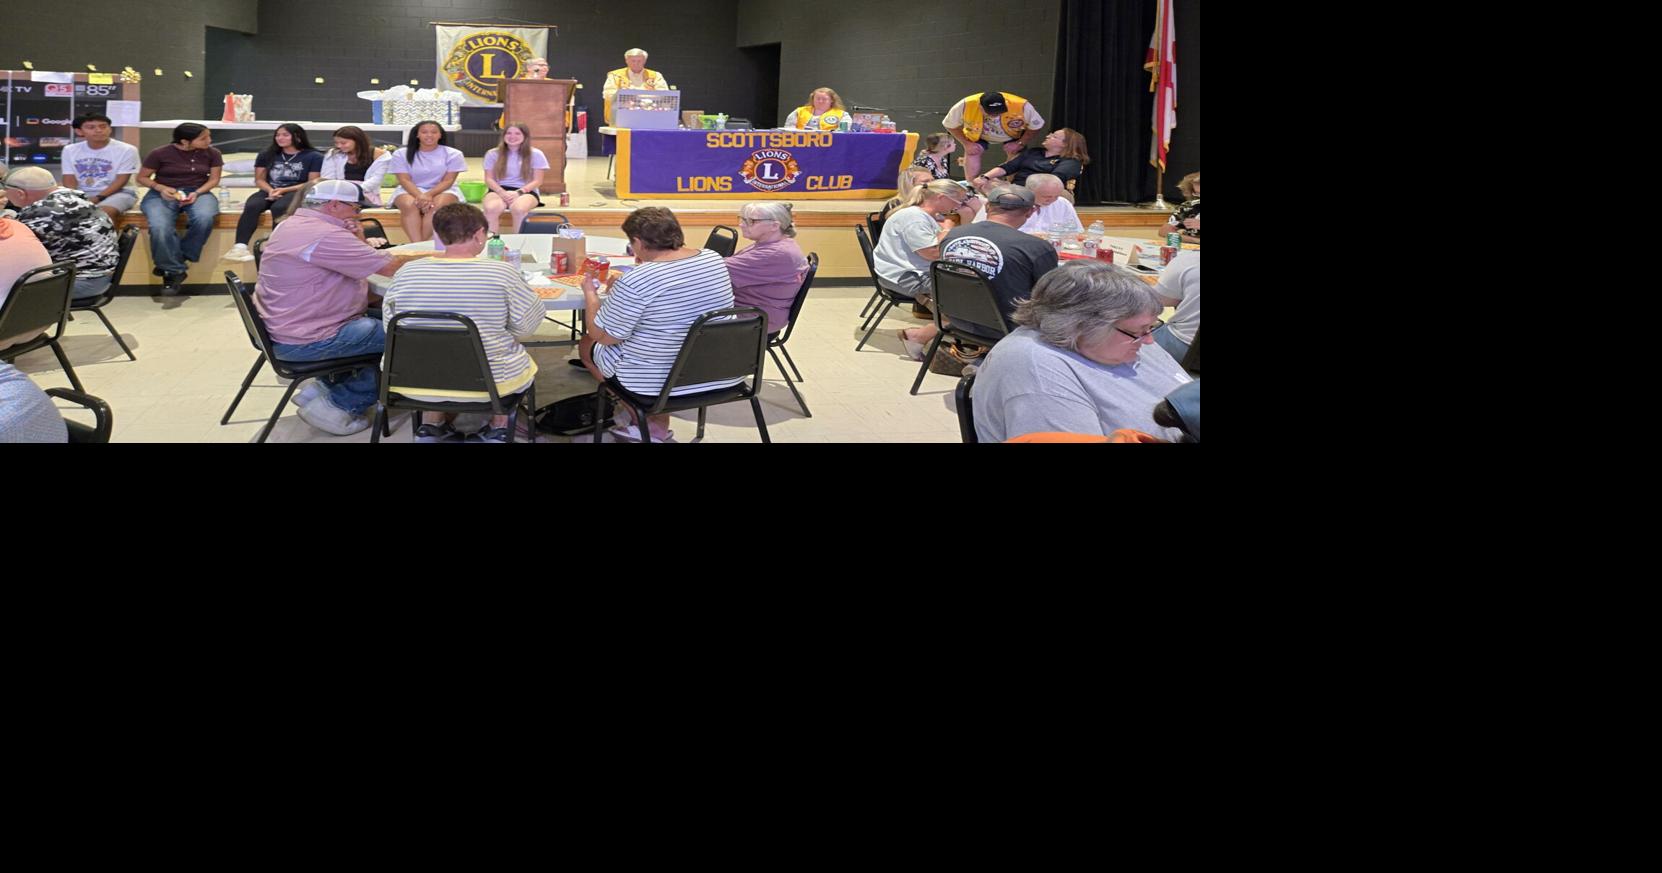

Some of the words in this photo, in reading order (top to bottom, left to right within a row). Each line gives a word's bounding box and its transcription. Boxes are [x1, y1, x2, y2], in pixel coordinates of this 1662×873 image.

[468, 36, 519, 50] LIONS
[480, 53, 506, 79] L
[706, 132, 833, 148] SCOTTSBORO
[755, 151, 788, 161] LIONS
[763, 162, 779, 180] L
[677, 176, 733, 192] LIONS
[806, 175, 853, 190] CLUB
